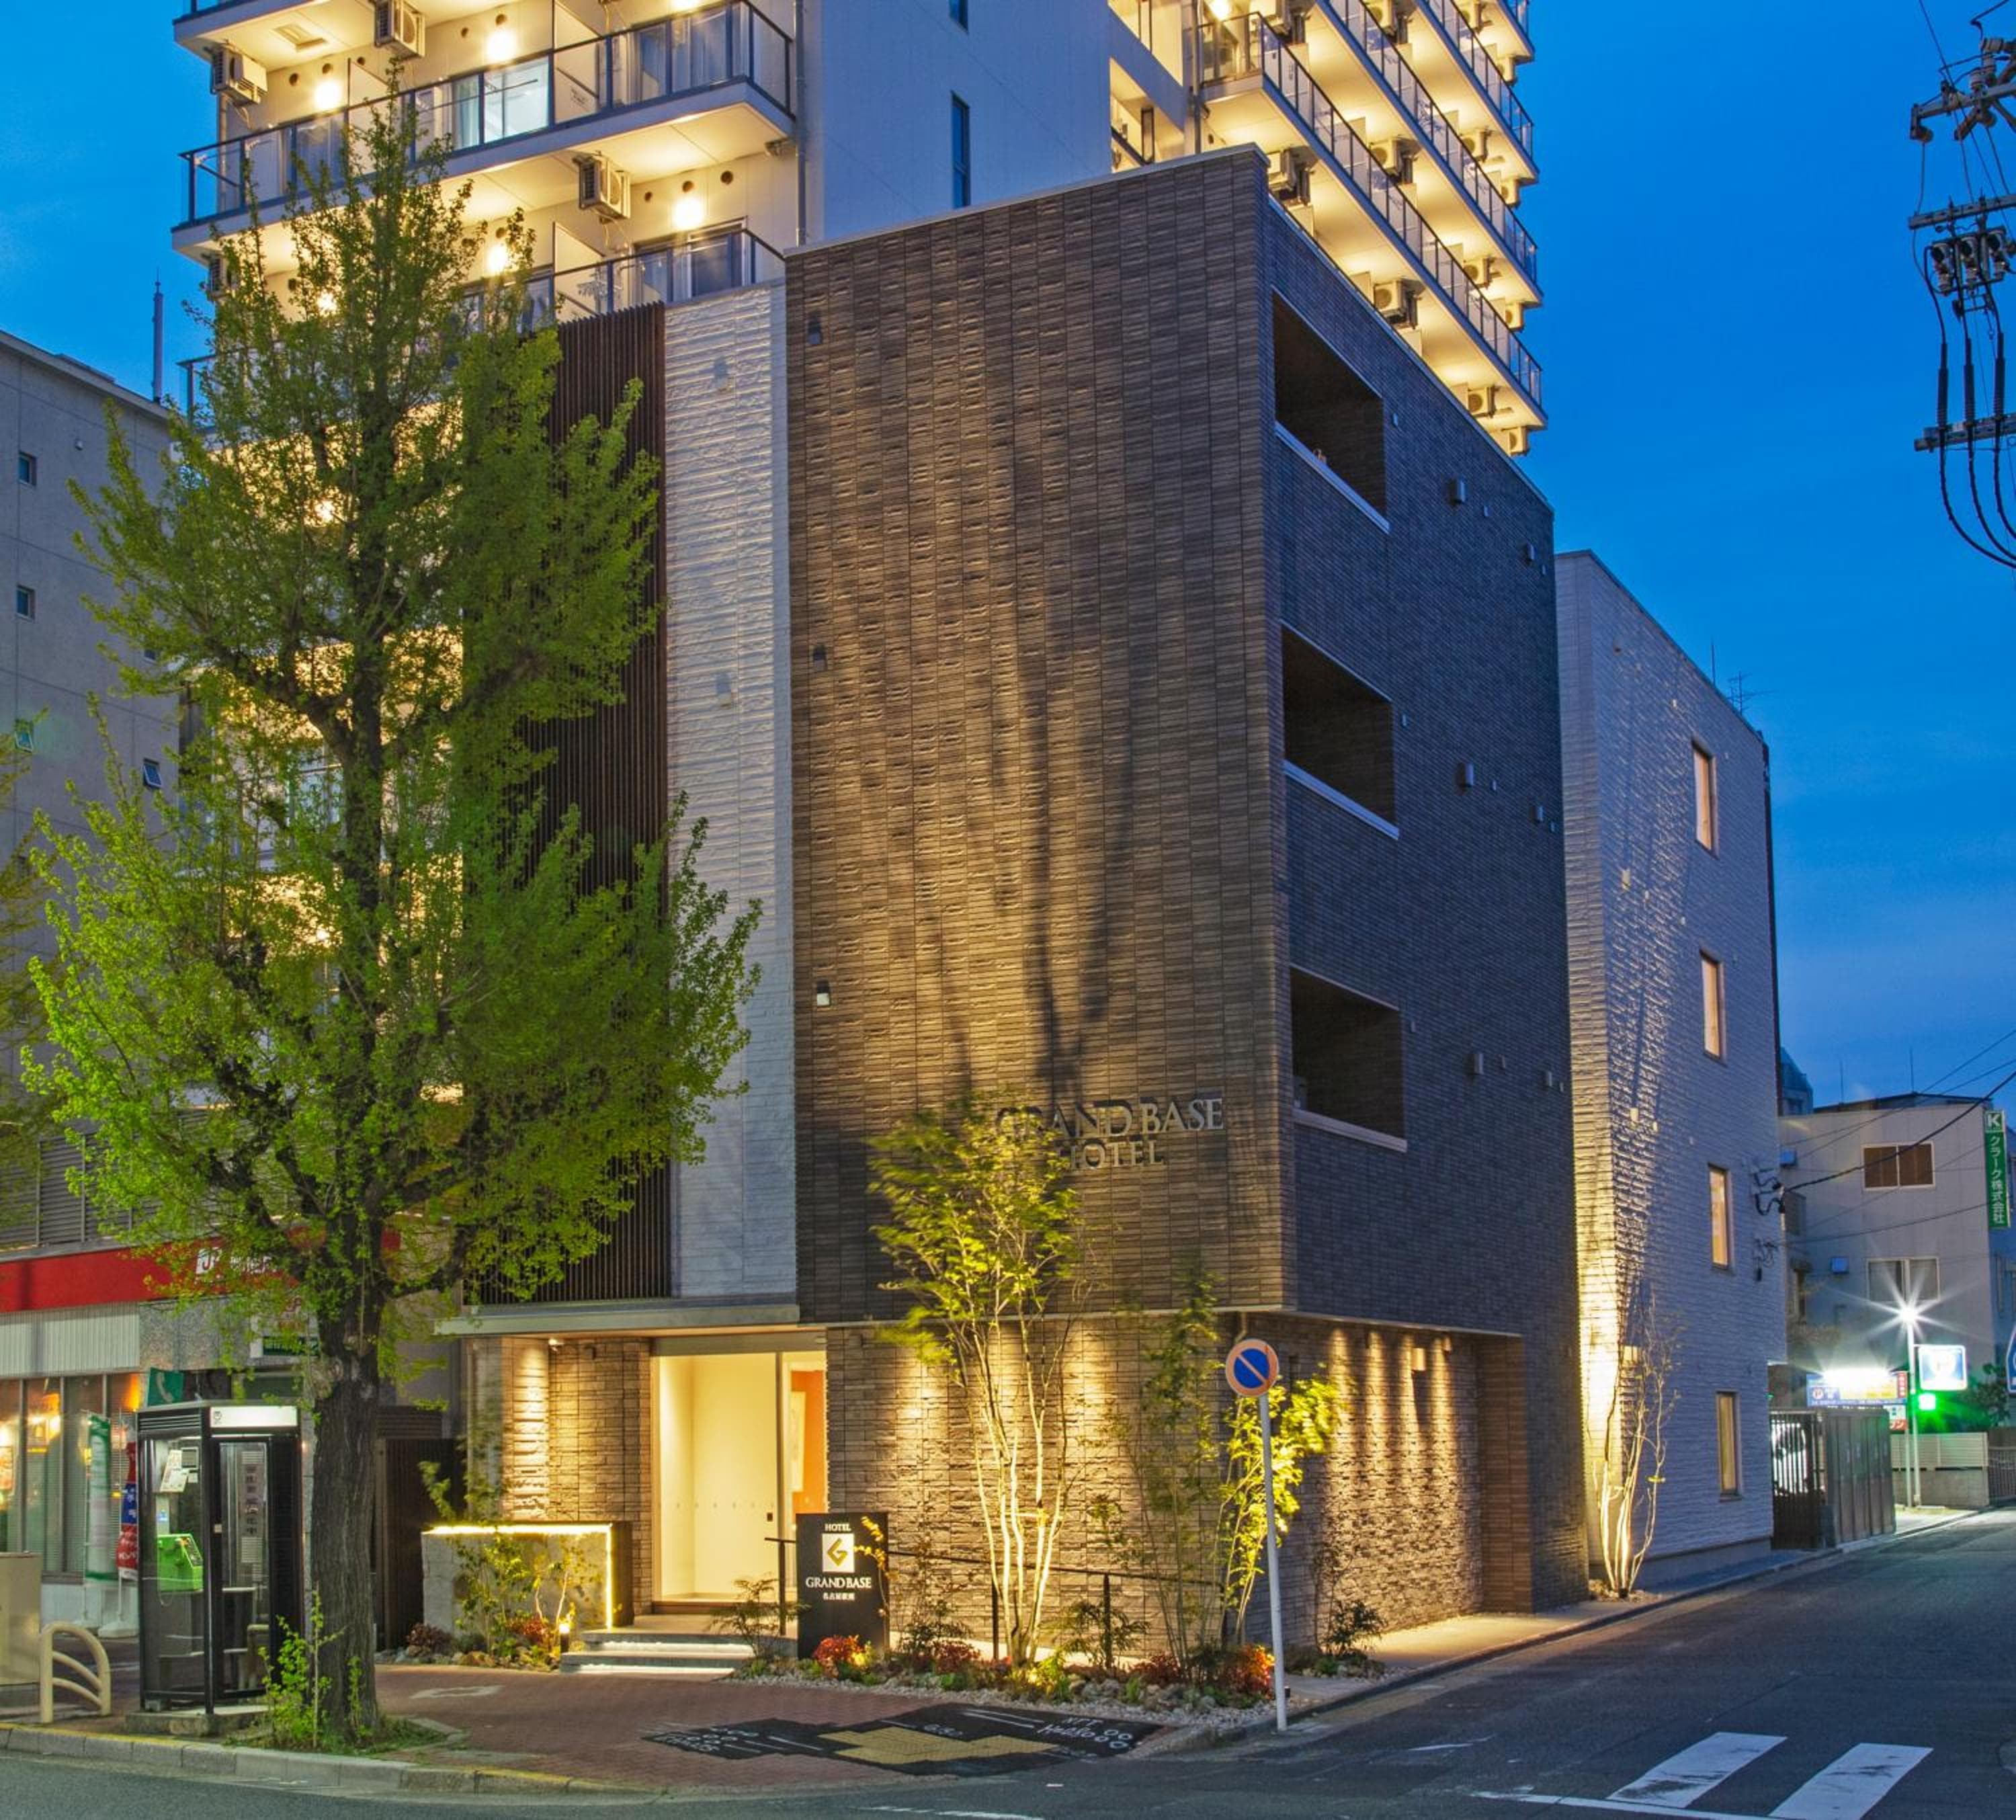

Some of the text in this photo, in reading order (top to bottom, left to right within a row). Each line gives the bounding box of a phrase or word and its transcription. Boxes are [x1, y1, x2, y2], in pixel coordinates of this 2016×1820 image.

[1140, 1098, 1224, 1135] BASE
[1987, 1114, 2001, 1128] K
[1990, 1136, 2005, 1224] クラーク株式会社
[825, 1524, 851, 1532] HOTEL
[806, 1577, 872, 1588] GRAND BASE
